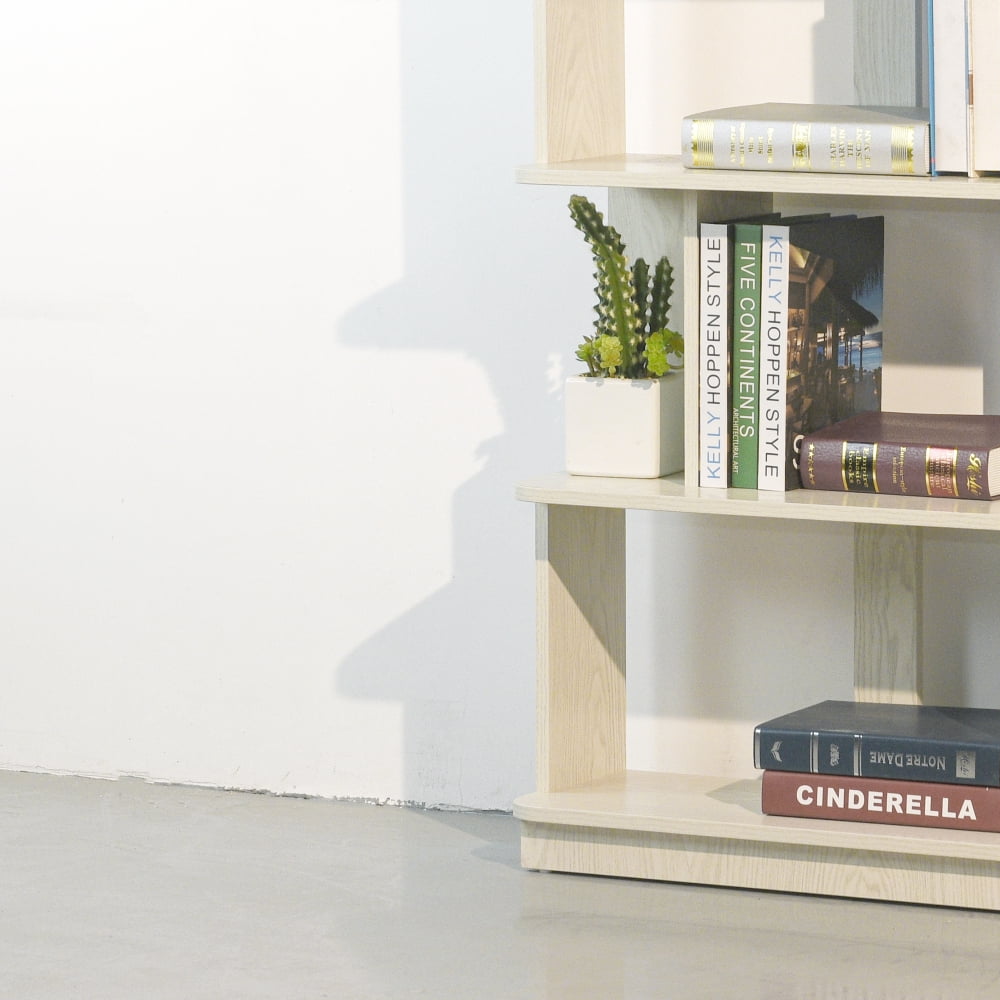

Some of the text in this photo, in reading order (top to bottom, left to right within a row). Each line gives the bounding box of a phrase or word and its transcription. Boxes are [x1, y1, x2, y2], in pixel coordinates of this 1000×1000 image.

[706, 238, 721, 479] KELLY HOPPEN STYLE
[739, 242, 756, 438] FIVE CONTINENTS
[765, 236, 783, 478] KELLY HOPPEN STYLE
[796, 784, 977, 821] CINDERELLA
[869, 751, 904, 767] DAME
[905, 753, 946, 771] NOTRE
